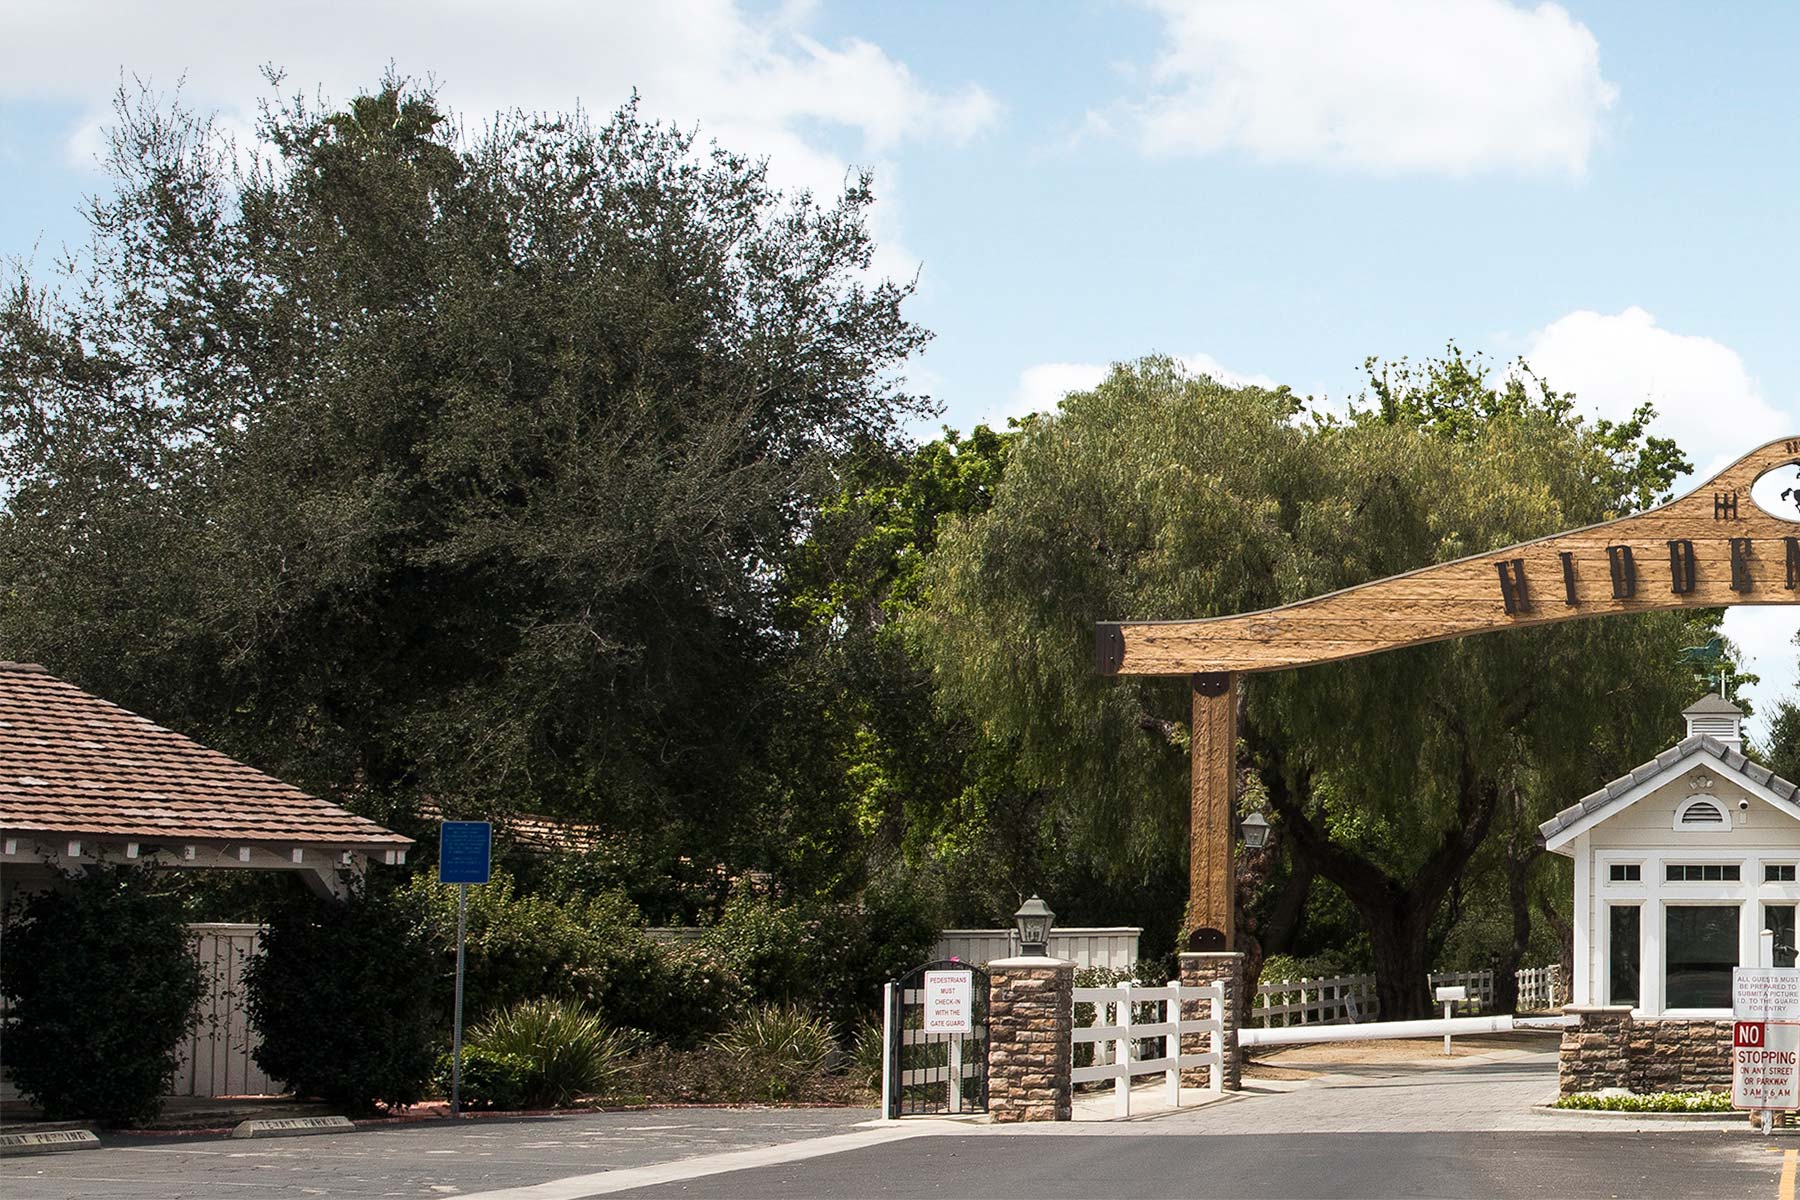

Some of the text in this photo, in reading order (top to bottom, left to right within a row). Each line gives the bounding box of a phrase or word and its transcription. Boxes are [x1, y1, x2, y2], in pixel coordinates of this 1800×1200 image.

[1739, 1025, 1759, 1044] NO
[1738, 1050, 1796, 1065] STOPPING
[1769, 1067, 1793, 1075] STREET
[1744, 1077, 1788, 1085] OR PARKWAY
[1743, 1088, 1748, 1096] 3
[1750, 1088, 1761, 1096] AM
[36, 1131, 86, 1143] PARKING
